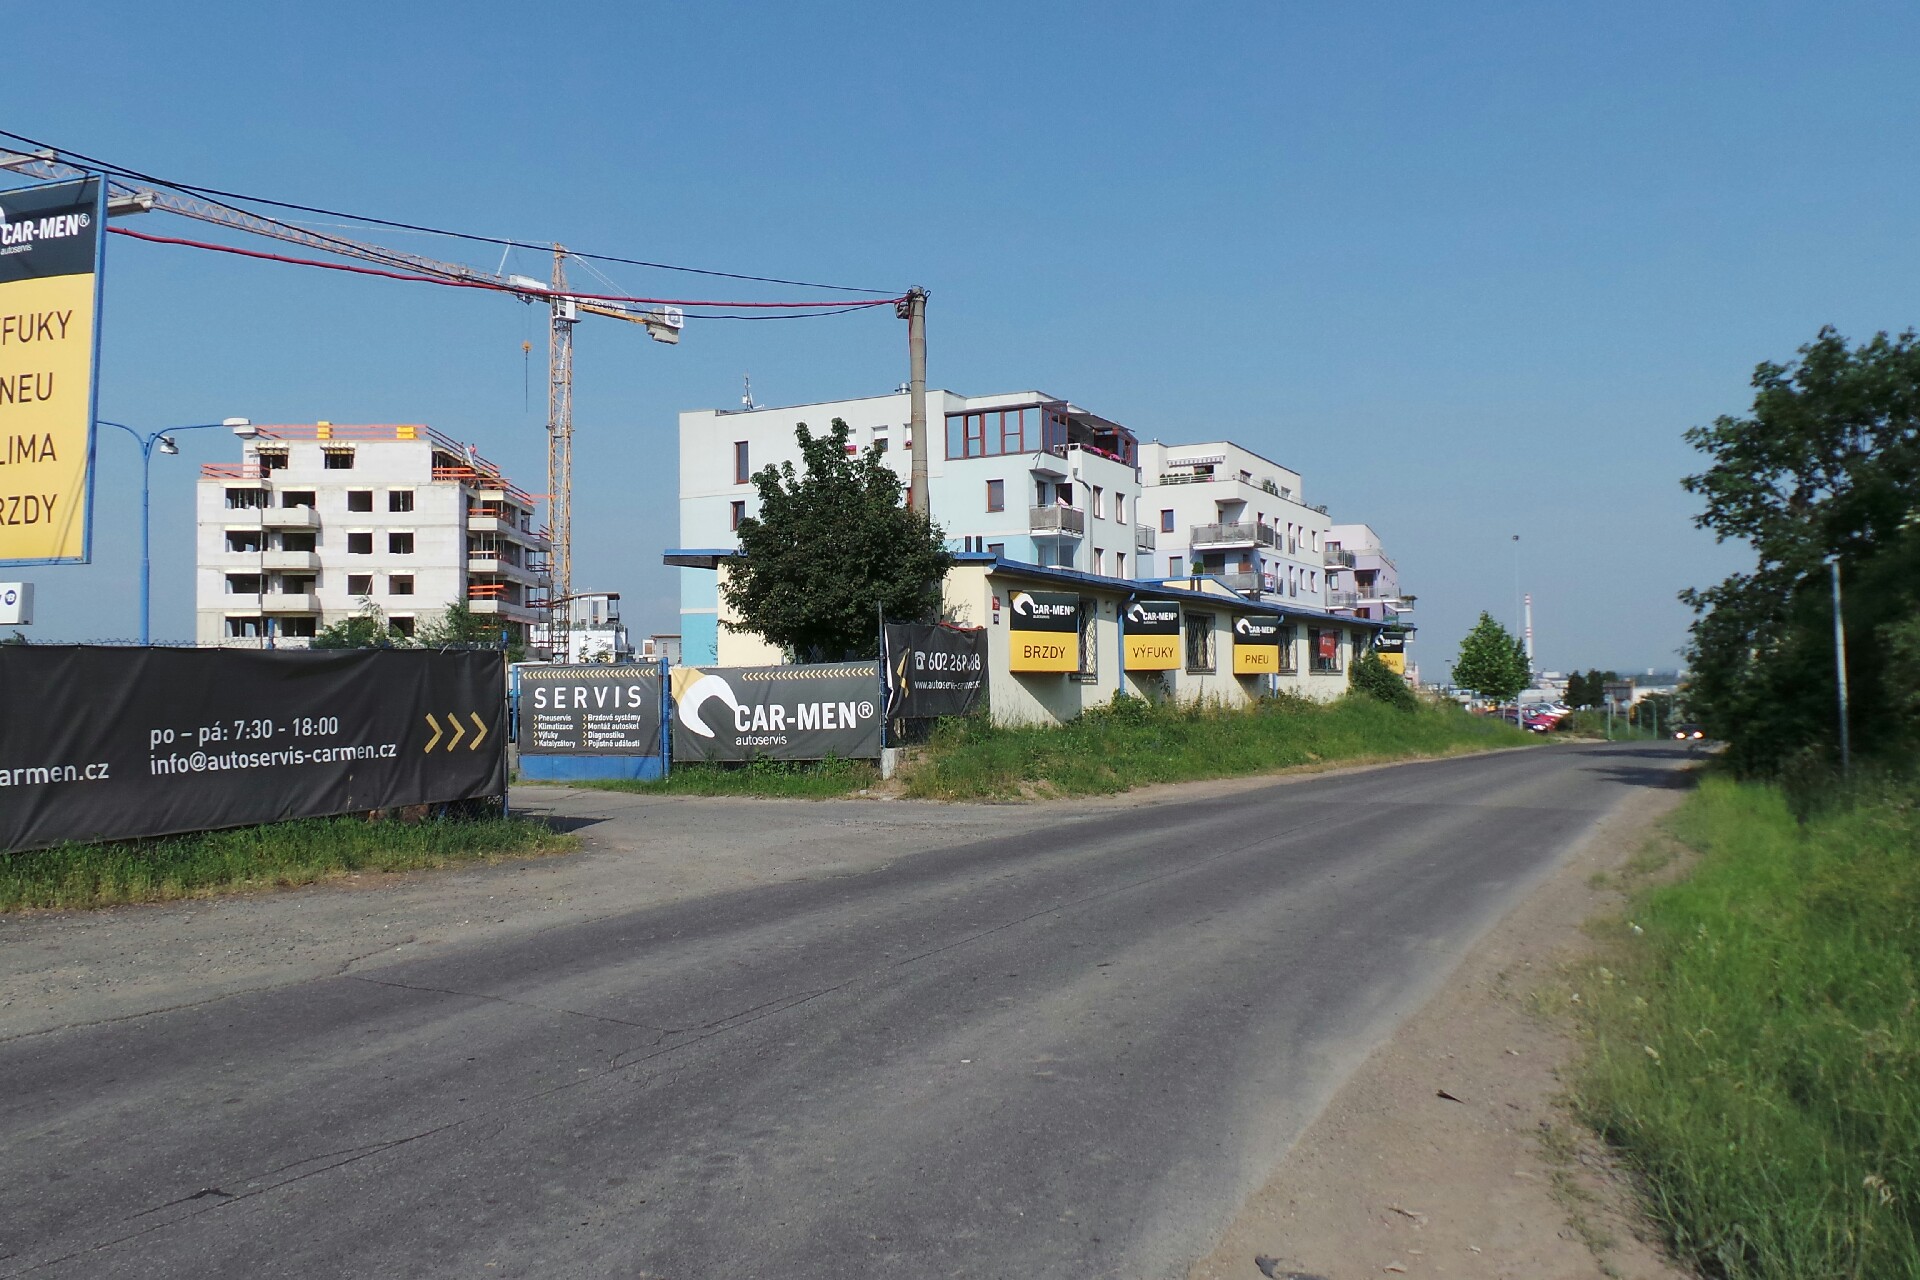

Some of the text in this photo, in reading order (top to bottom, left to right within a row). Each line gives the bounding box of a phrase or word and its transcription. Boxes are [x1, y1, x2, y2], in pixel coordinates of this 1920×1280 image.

[0, 243, 32, 255] autoservis
[0, 309, 72, 346] FUKY
[1023, 645, 1066, 659] BRZDY
[1132, 644, 1174, 658] VÝFUKY
[928, 652, 948, 671] 602
[1245, 654, 1269, 664] PNEU
[533, 685, 641, 709] SERVIS
[587, 713, 641, 722] Brzdové systémy
[538, 722, 574, 730] Klimatizace
[587, 722, 640, 730] Montáž autoskel
[150, 728, 175, 750] po
[199, 720, 228, 747] pá:
[234, 719, 273, 740] 7:30
[292, 716, 339, 737] 18:00
[538, 731, 559, 740] Výfuky
[587, 731, 625, 740] Diagnostika
[538, 740, 576, 749] Katalyzátory
[587, 740, 640, 749] Pojistné události
[735, 733, 788, 746] autoservis
[150, 743, 397, 775] info@autoservis-carmen.cz
[0, 763, 110, 787] armen.cz
